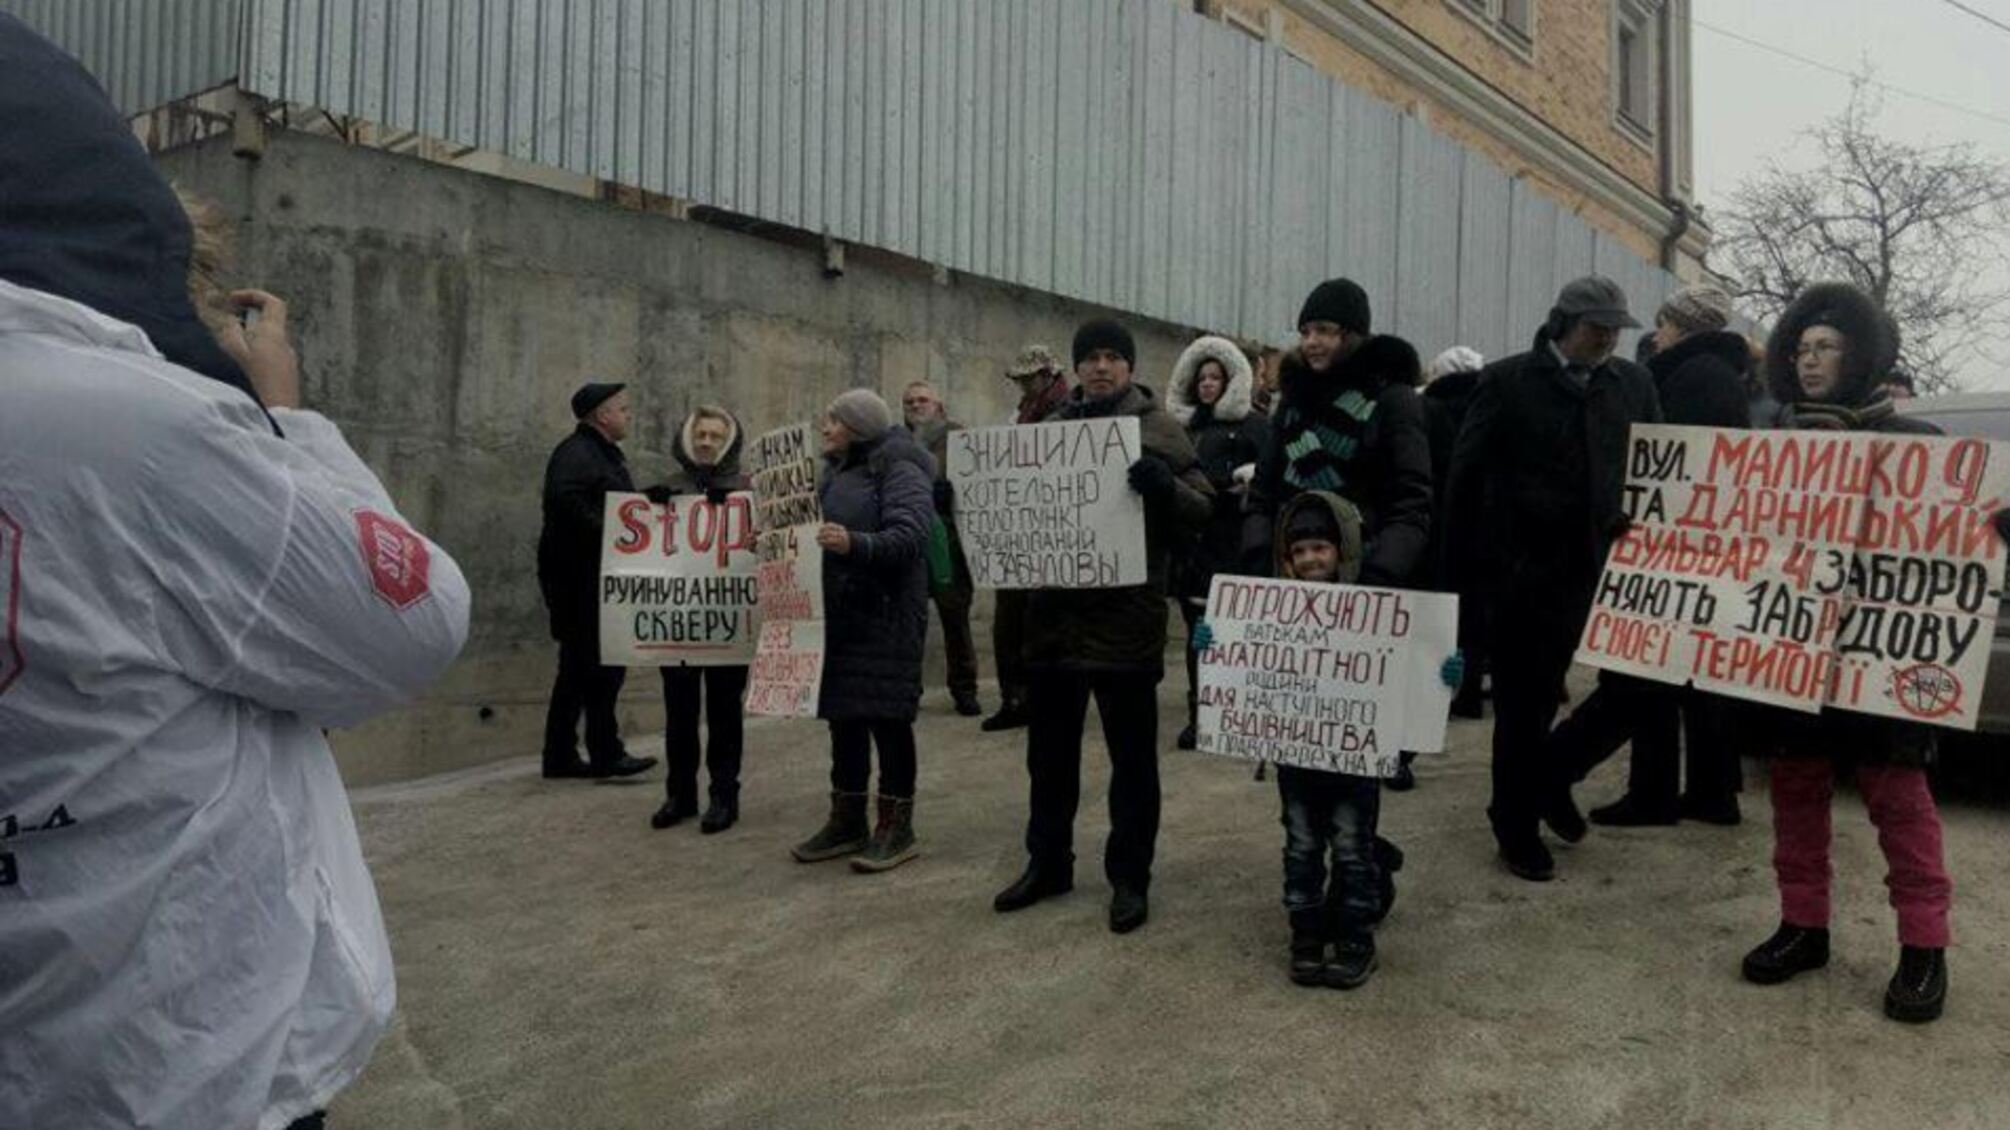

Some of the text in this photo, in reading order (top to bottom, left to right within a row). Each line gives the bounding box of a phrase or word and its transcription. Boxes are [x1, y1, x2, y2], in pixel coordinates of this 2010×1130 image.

[958, 420, 1131, 477] ЗНИЩИЛА
[1630, 438, 1692, 482] ВУЛ.
[1706, 432, 1931, 499] МАЛИШКО
[960, 470, 1100, 508] КОТЕЛЬНЮ
[1624, 483, 1999, 560] ТА ДАРНИЦЬКИЙ
[1611, 524, 1770, 582] БУЛЬВАР
[604, 575, 758, 606] РУЙНУВАННЮ
[1215, 582, 1411, 637] ПОГРОЖУЮТЬ
[1597, 571, 1718, 626] НЯЮТЬ
[634, 610, 738, 642] СКВЕРУ
[1198, 685, 1378, 726] ДЛЯ НАСТУПНОГО
[1220, 710, 1379, 753] БУДІВНИЦТВА
